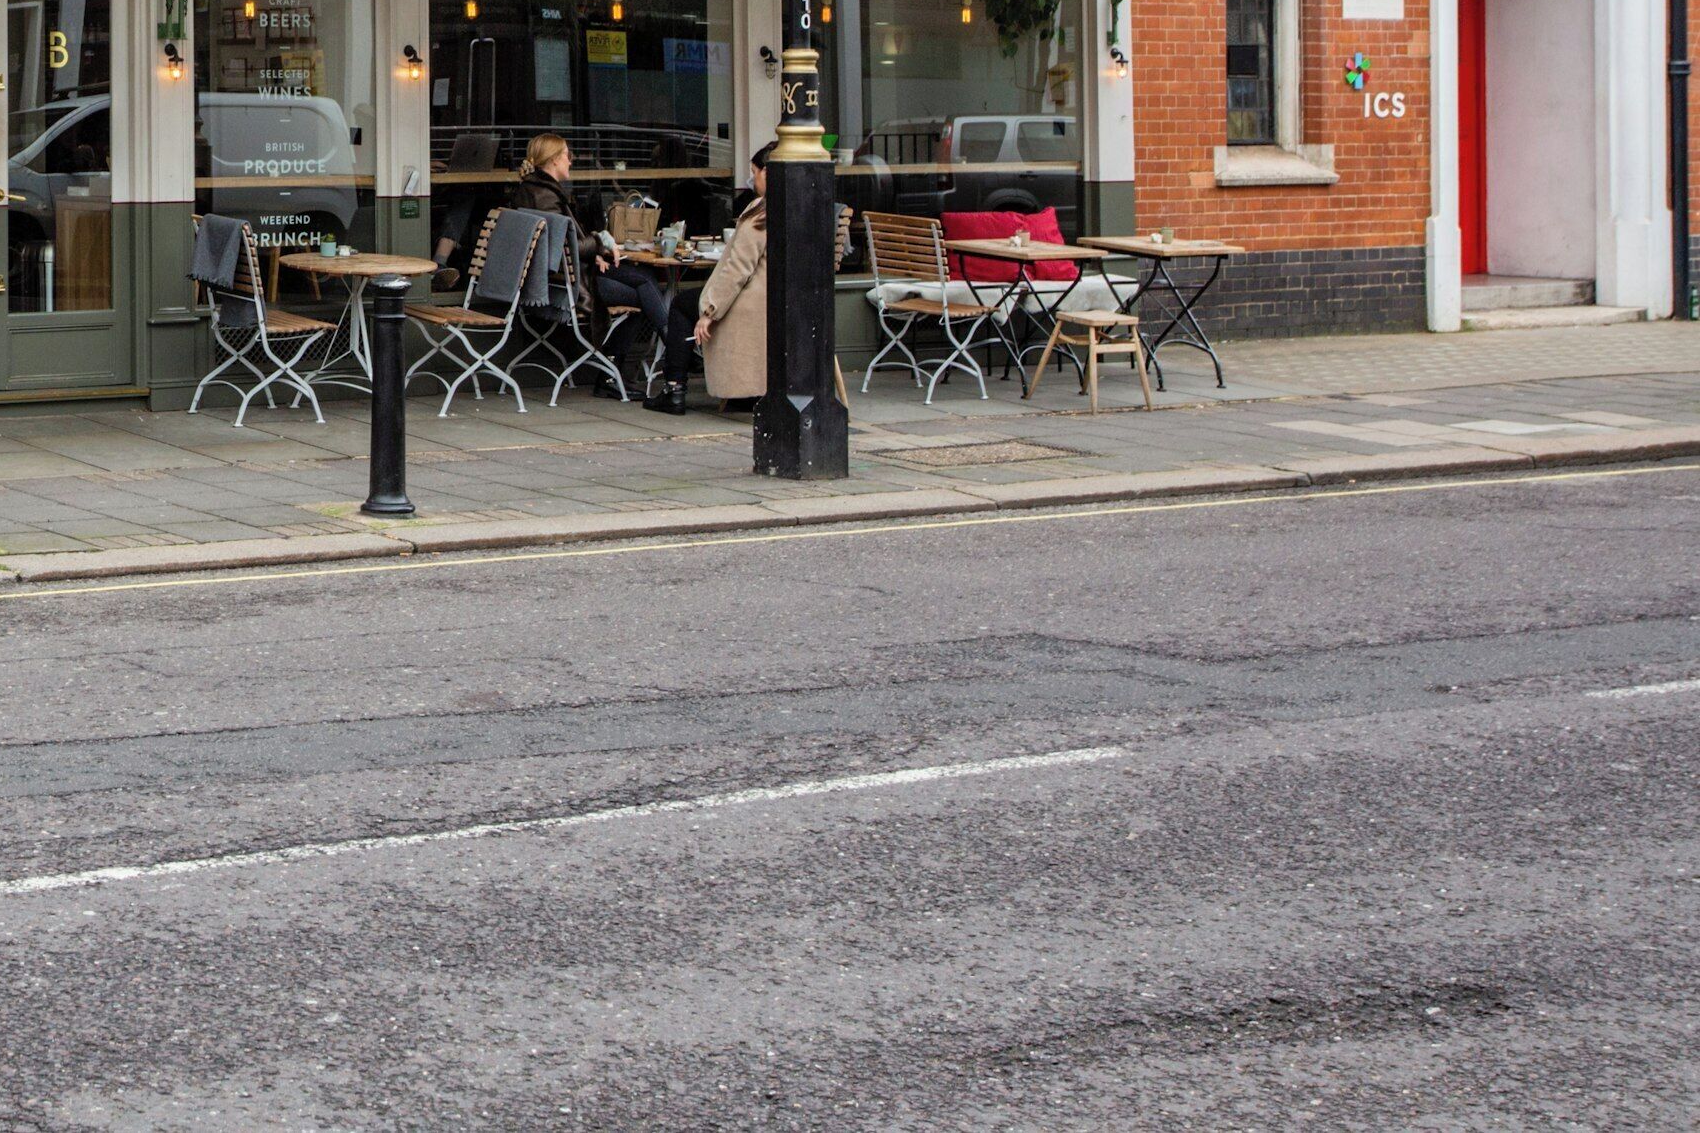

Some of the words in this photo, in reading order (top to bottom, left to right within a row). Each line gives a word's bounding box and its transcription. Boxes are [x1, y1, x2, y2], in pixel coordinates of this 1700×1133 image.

[259, 13, 311, 28] BEERS
[49, 30, 69, 68] B
[260, 69, 311, 79] SELECTED
[258, 86, 312, 101] WINES
[1364, 92, 1406, 118] ICS
[265, 142, 305, 152] BRITISH
[244, 159, 326, 175] PRODUCE
[260, 214, 311, 225] WEEKEND
